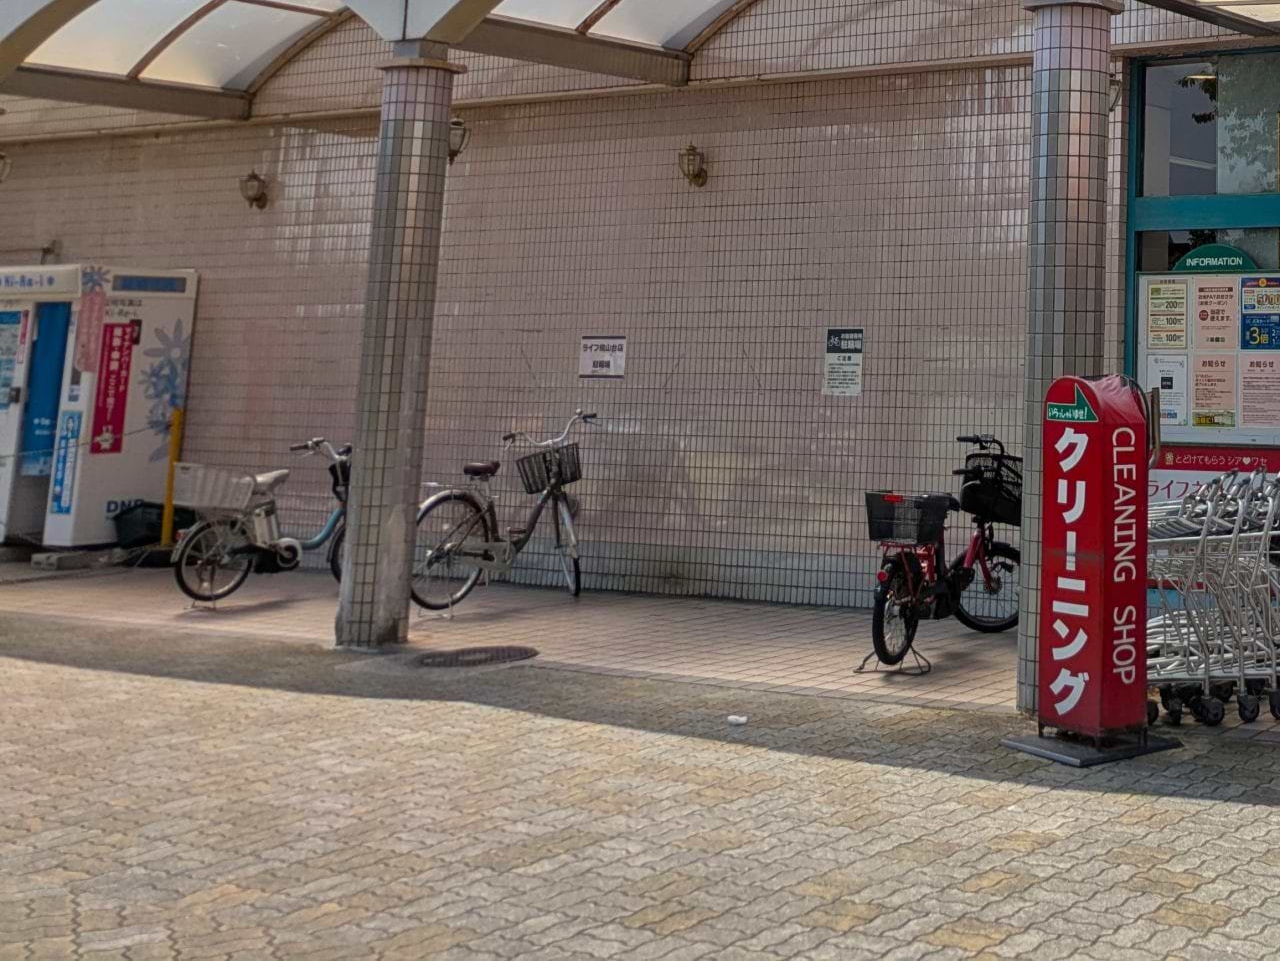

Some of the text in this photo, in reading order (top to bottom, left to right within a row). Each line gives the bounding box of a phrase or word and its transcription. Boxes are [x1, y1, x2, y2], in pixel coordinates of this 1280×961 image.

[1185, 256, 1243, 267] INFORMATION
[1165, 300, 1178, 309] 200
[1166, 317, 1178, 326] 100
[1166, 334, 1178, 343] 100
[1202, 360, 1226, 368] お知らせ
[1249, 360, 1274, 368] お知らせ
[1175, 454, 1226, 465] とどけてもらう
[1112, 427, 1137, 685] CLEANING SHOP
[1050, 427, 1090, 716] クリーニング
